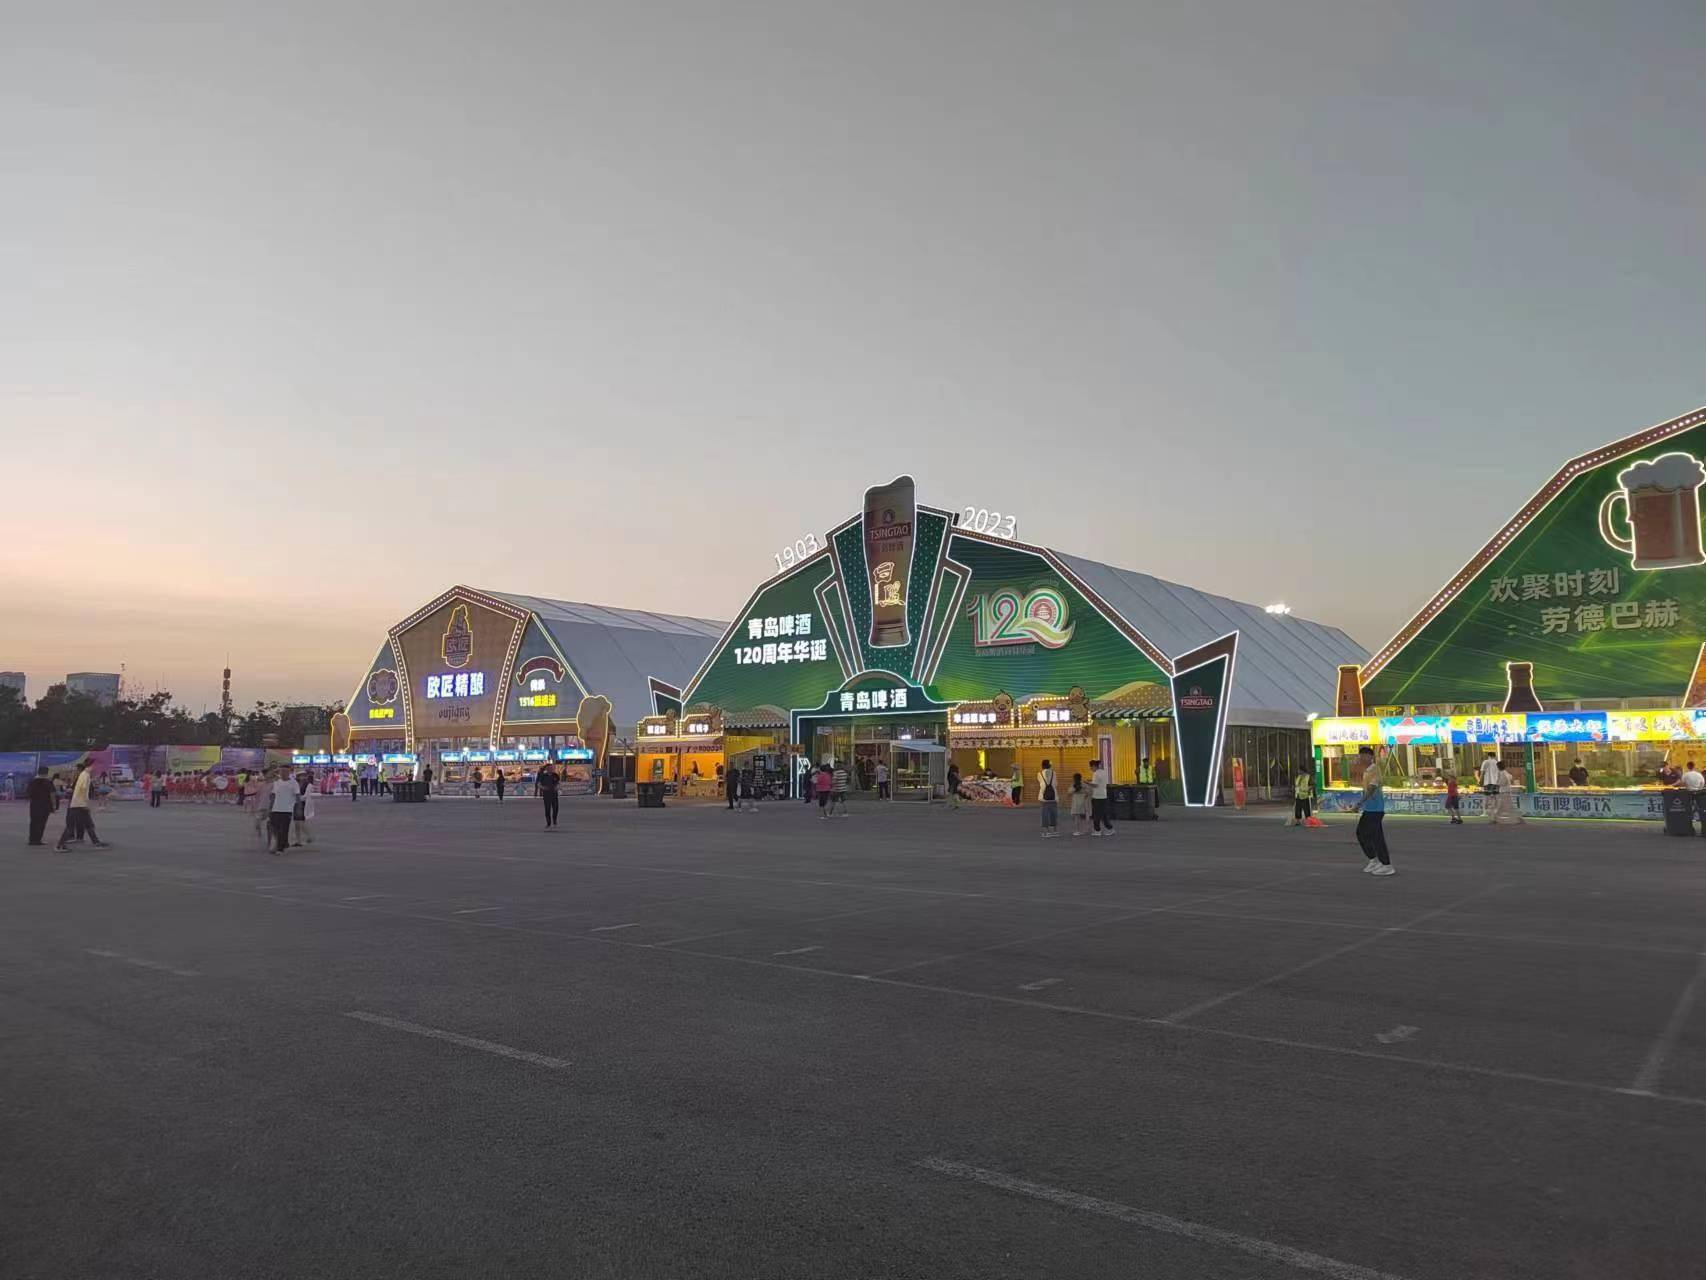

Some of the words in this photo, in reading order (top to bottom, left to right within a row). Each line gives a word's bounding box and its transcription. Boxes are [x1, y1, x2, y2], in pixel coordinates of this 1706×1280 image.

[870, 525, 909, 540] TSINGTAO
[961, 506, 1015, 539] 2023
[775, 533, 818, 573] 1903
[1490, 567, 1620, 602] 欢聚时刻
[748, 613, 812, 640] 青岛啤酒
[1540, 599, 1680, 634] 劳德巴赫
[734, 639, 827, 665] 120周年华诞
[427, 671, 484, 699] 欧匠精酿
[840, 688, 908, 711] 青岛啤酒
[1180, 698, 1213, 707] TSINGTAO
[1533, 796, 1612, 813] 嗨啤畅饮
